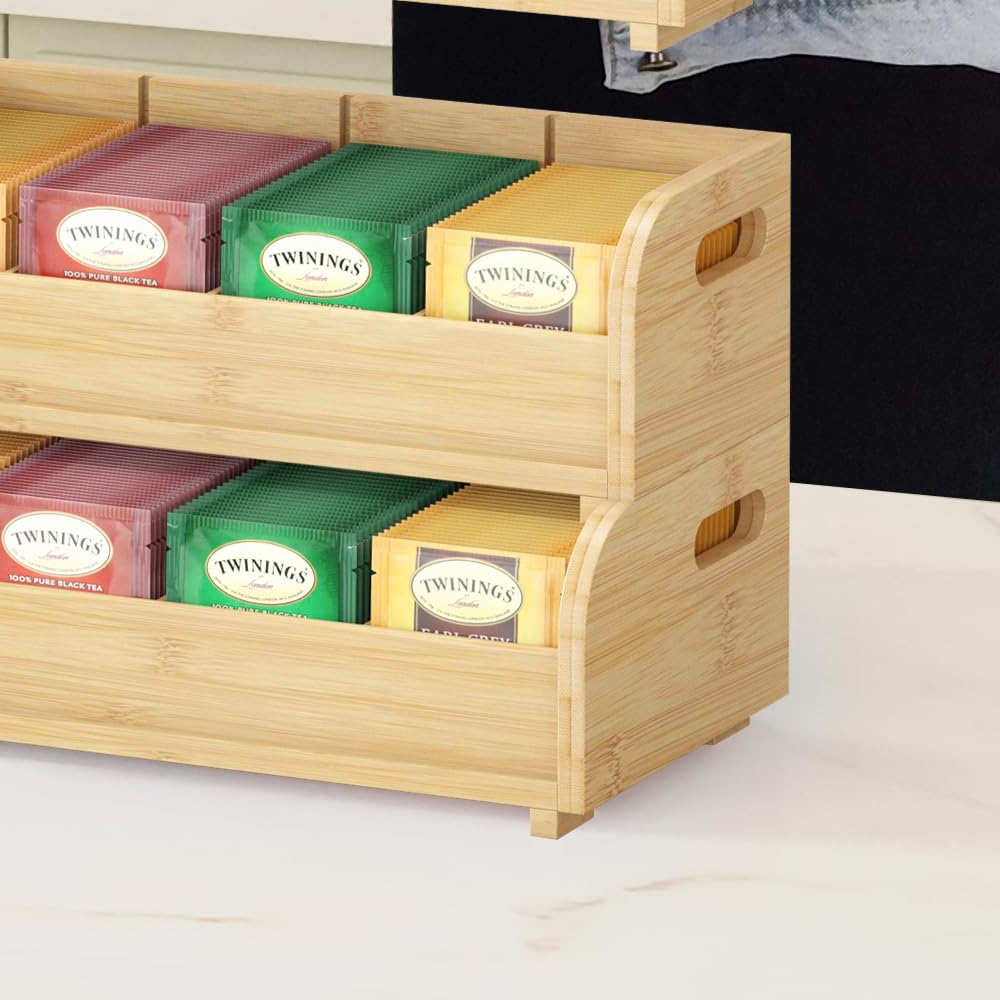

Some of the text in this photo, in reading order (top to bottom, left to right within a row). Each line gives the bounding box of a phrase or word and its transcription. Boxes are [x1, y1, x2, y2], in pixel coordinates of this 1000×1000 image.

[66, 225, 158, 250] TWININGS
[269, 251, 362, 276] TWININGS
[64, 270, 158, 286] 100% PURE BLACK TEA
[474, 267, 570, 292] TWININGS
[11, 530, 103, 555] TWININGS
[9, 574, 103, 592] 100% PURE BLACK TEA
[214, 558, 308, 584] TWININGS
[420, 577, 515, 603] TWININGS
